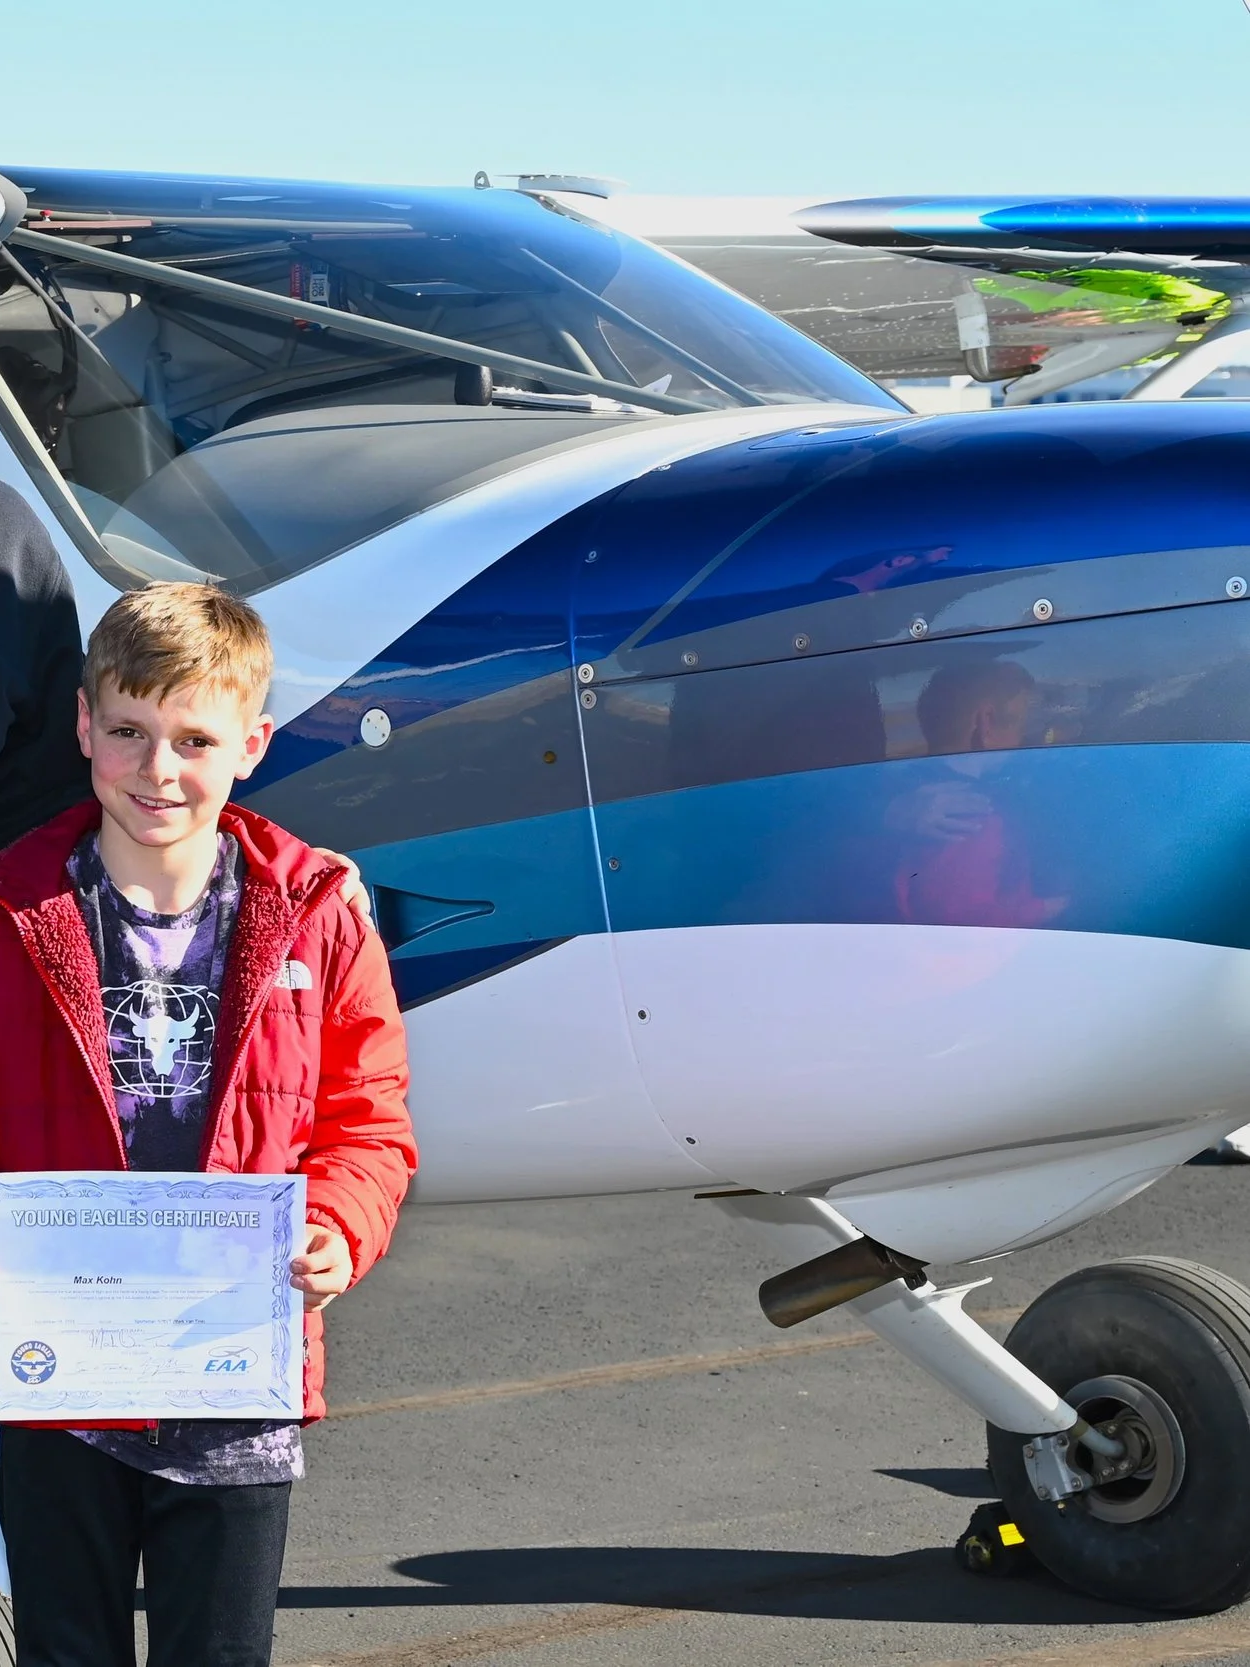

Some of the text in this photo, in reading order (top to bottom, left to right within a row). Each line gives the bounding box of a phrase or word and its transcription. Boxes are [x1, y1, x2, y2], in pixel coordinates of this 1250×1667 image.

[11, 1209, 260, 1228] YOUNG EAGLES CERTIFICATE
[73, 1275, 123, 1285] Max Kohn
[204, 1359, 248, 1372] EAA
